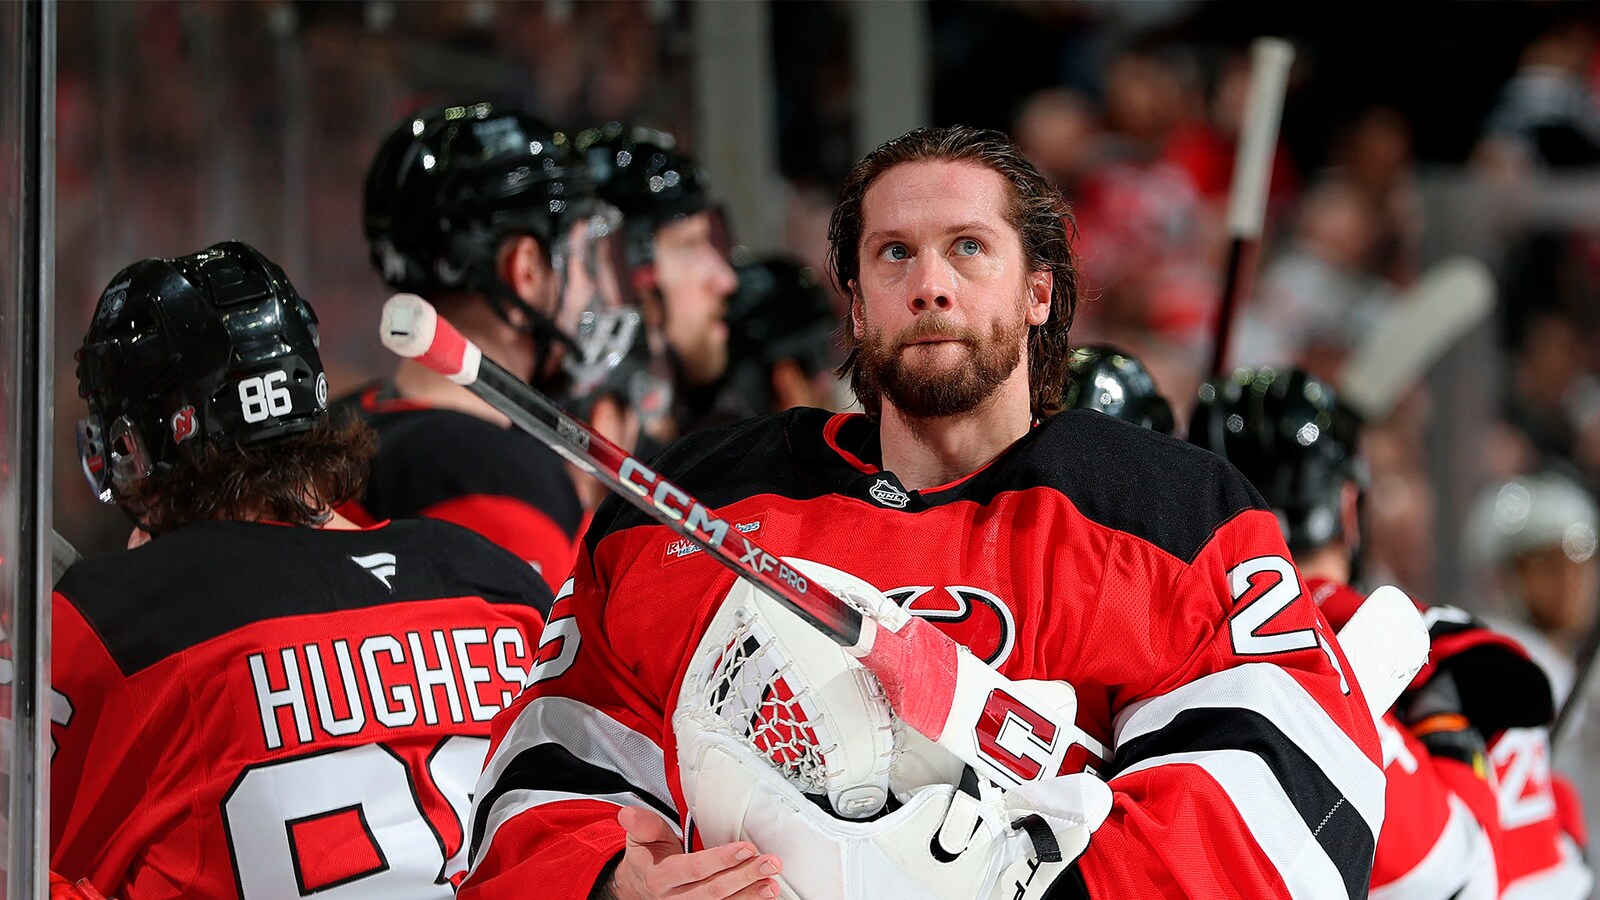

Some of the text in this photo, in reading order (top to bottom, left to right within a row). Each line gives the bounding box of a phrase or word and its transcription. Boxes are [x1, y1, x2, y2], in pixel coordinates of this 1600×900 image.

[238, 370, 292, 424] 86
[618, 456, 808, 594] CCM XF PRO
[247, 627, 529, 749] HUGHES
[1227, 555, 1350, 696] 2
